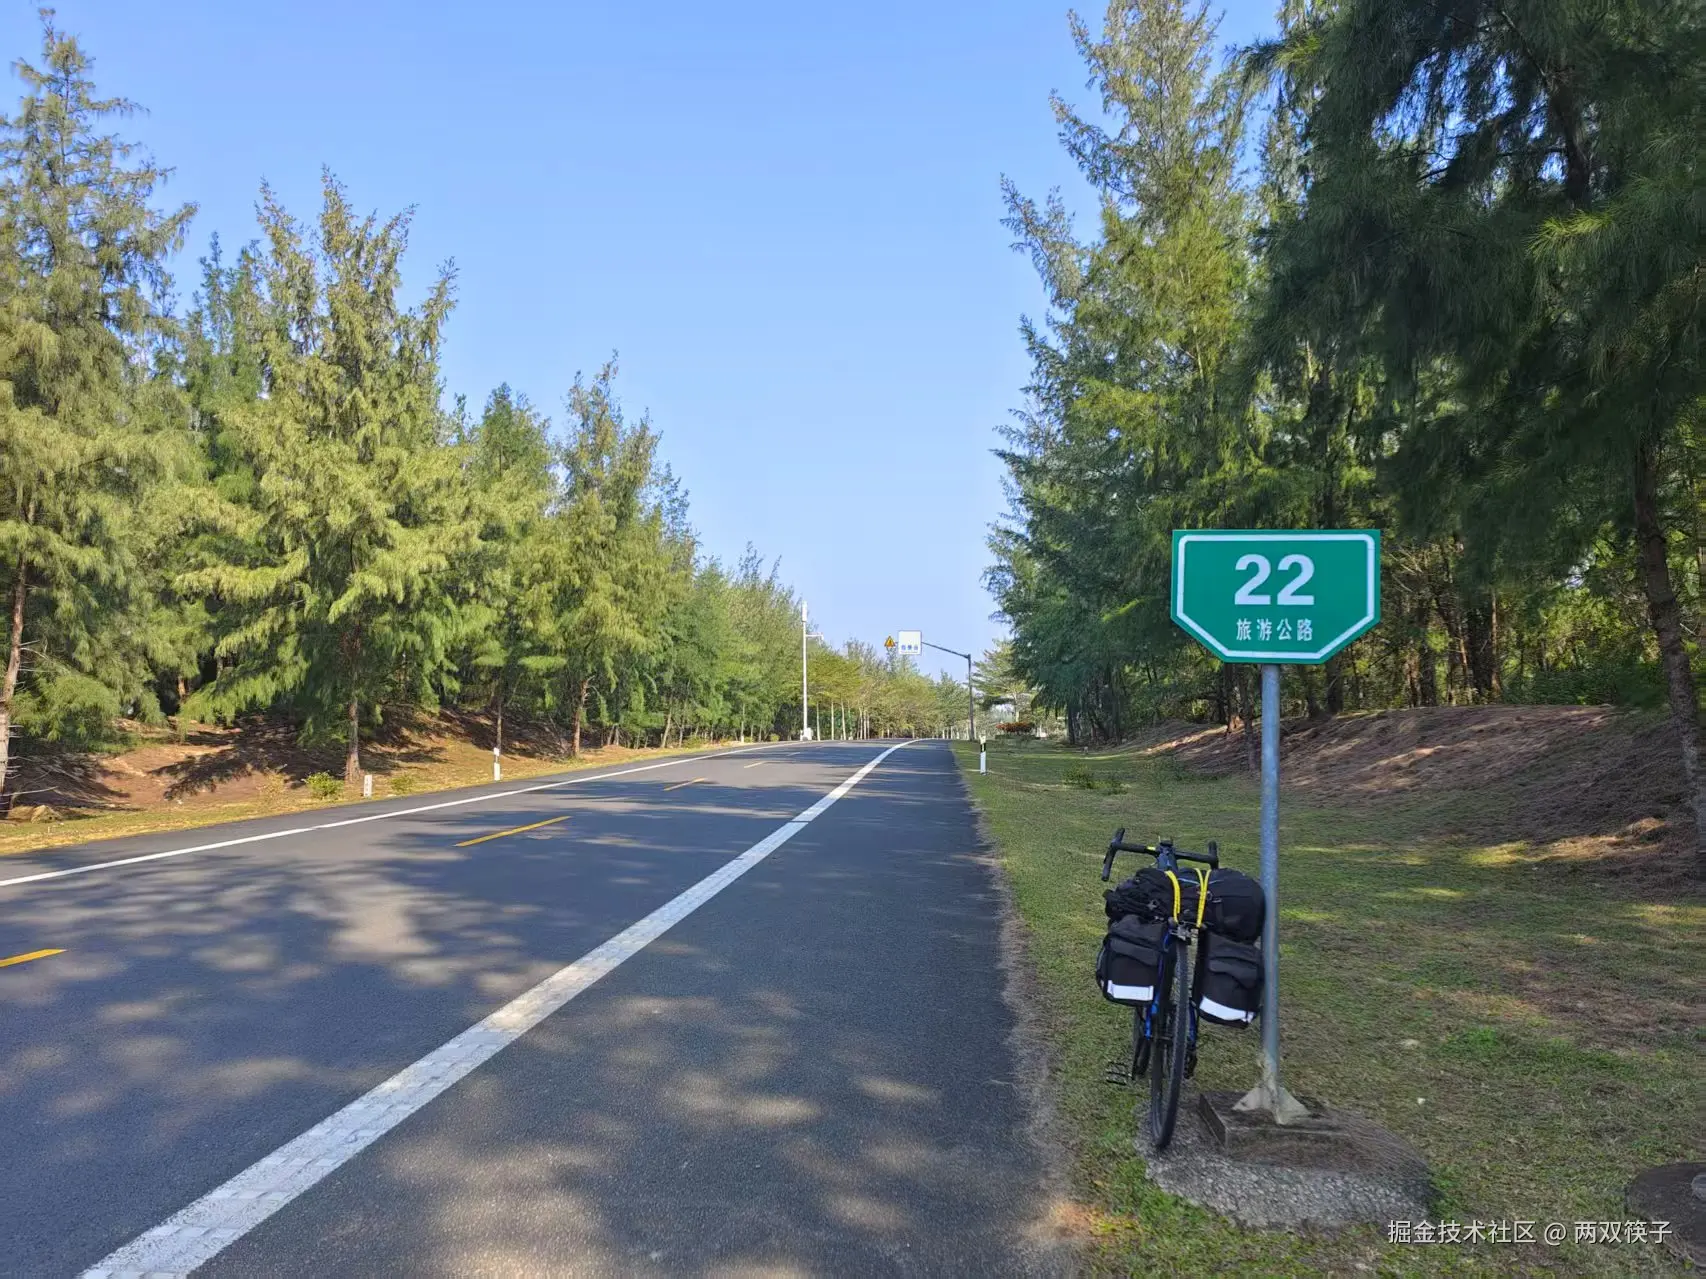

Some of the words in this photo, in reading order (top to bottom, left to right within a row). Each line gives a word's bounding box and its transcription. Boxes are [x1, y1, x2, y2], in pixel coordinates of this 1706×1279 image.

[1234, 554, 1315, 605] 22
[1236, 618, 1314, 641] 旅游公路
